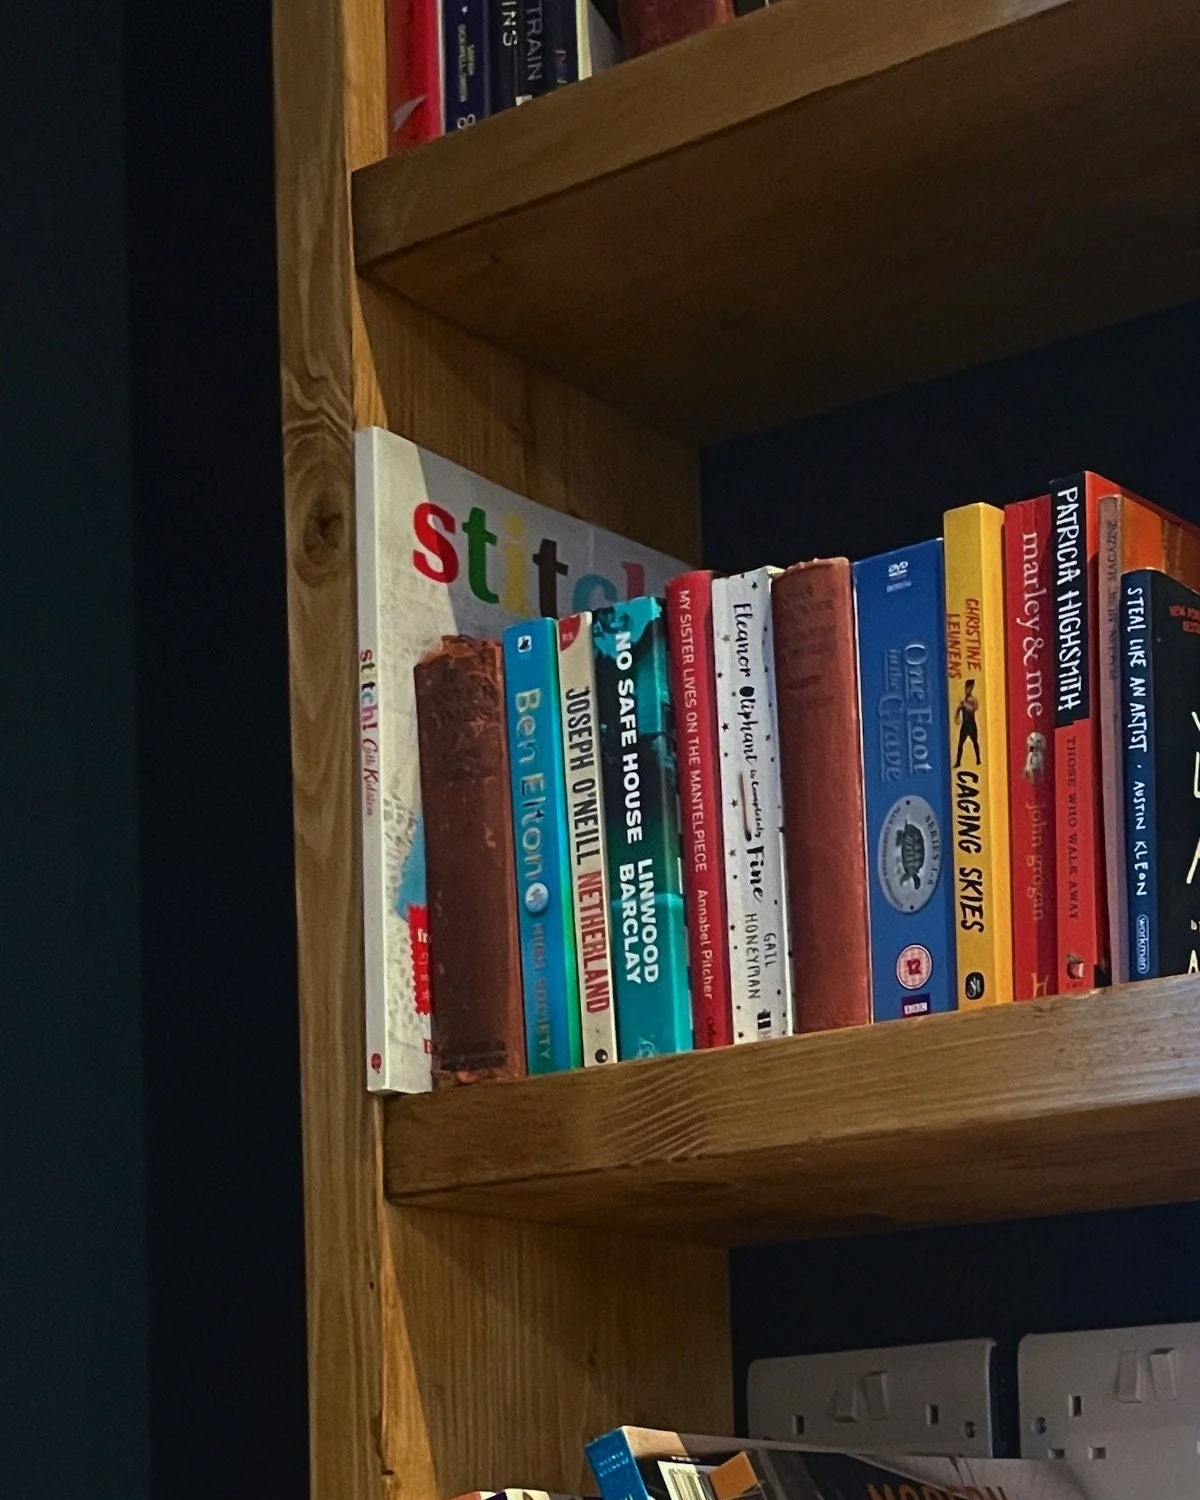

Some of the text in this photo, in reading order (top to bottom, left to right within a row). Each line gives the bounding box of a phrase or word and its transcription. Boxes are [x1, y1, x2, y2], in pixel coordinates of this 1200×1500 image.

[526, 0, 543, 80] TRAIN
[412, 501, 646, 621] stit
[679, 589, 690, 609] MY
[1017, 531, 1047, 631] marley
[1056, 486, 1082, 712] PATRICIA HIGHSMITH
[680, 612, 695, 665] SISTER
[965, 598, 981, 672] CHRISTINE
[682, 670, 697, 709] LIVES
[684, 713, 698, 732] ON
[733, 603, 759, 766] Eleanor Oliphant
[1025, 670, 1043, 719] me
[615, 631, 643, 845] NO SAFE HOUSE
[687, 735, 701, 766] THE
[1127, 587, 1148, 897] STEAL LIKE AN ARTIST AUSTIN KLEON
[515, 687, 547, 880] Ben Elton
[689, 770, 708, 873] MANTELPIECE
[565, 686, 610, 1014] JOSEPH O'NEILL NETHERLAND
[956, 770, 985, 934] CAGING SKIES
[1067, 736, 1079, 921] THOSE WHO WALK AWAY
[697, 889, 712, 945] Annabel
[747, 845, 765, 903] Fine
[619, 862, 641, 985] BARCLAY
[637, 858, 659, 983] LINWOOD
[744, 913, 761, 1000] HONEYMAN
[763, 932, 778, 968] GAIL
[1137, 915, 1149, 973] workman
[700, 950, 714, 1001] Pitcher
